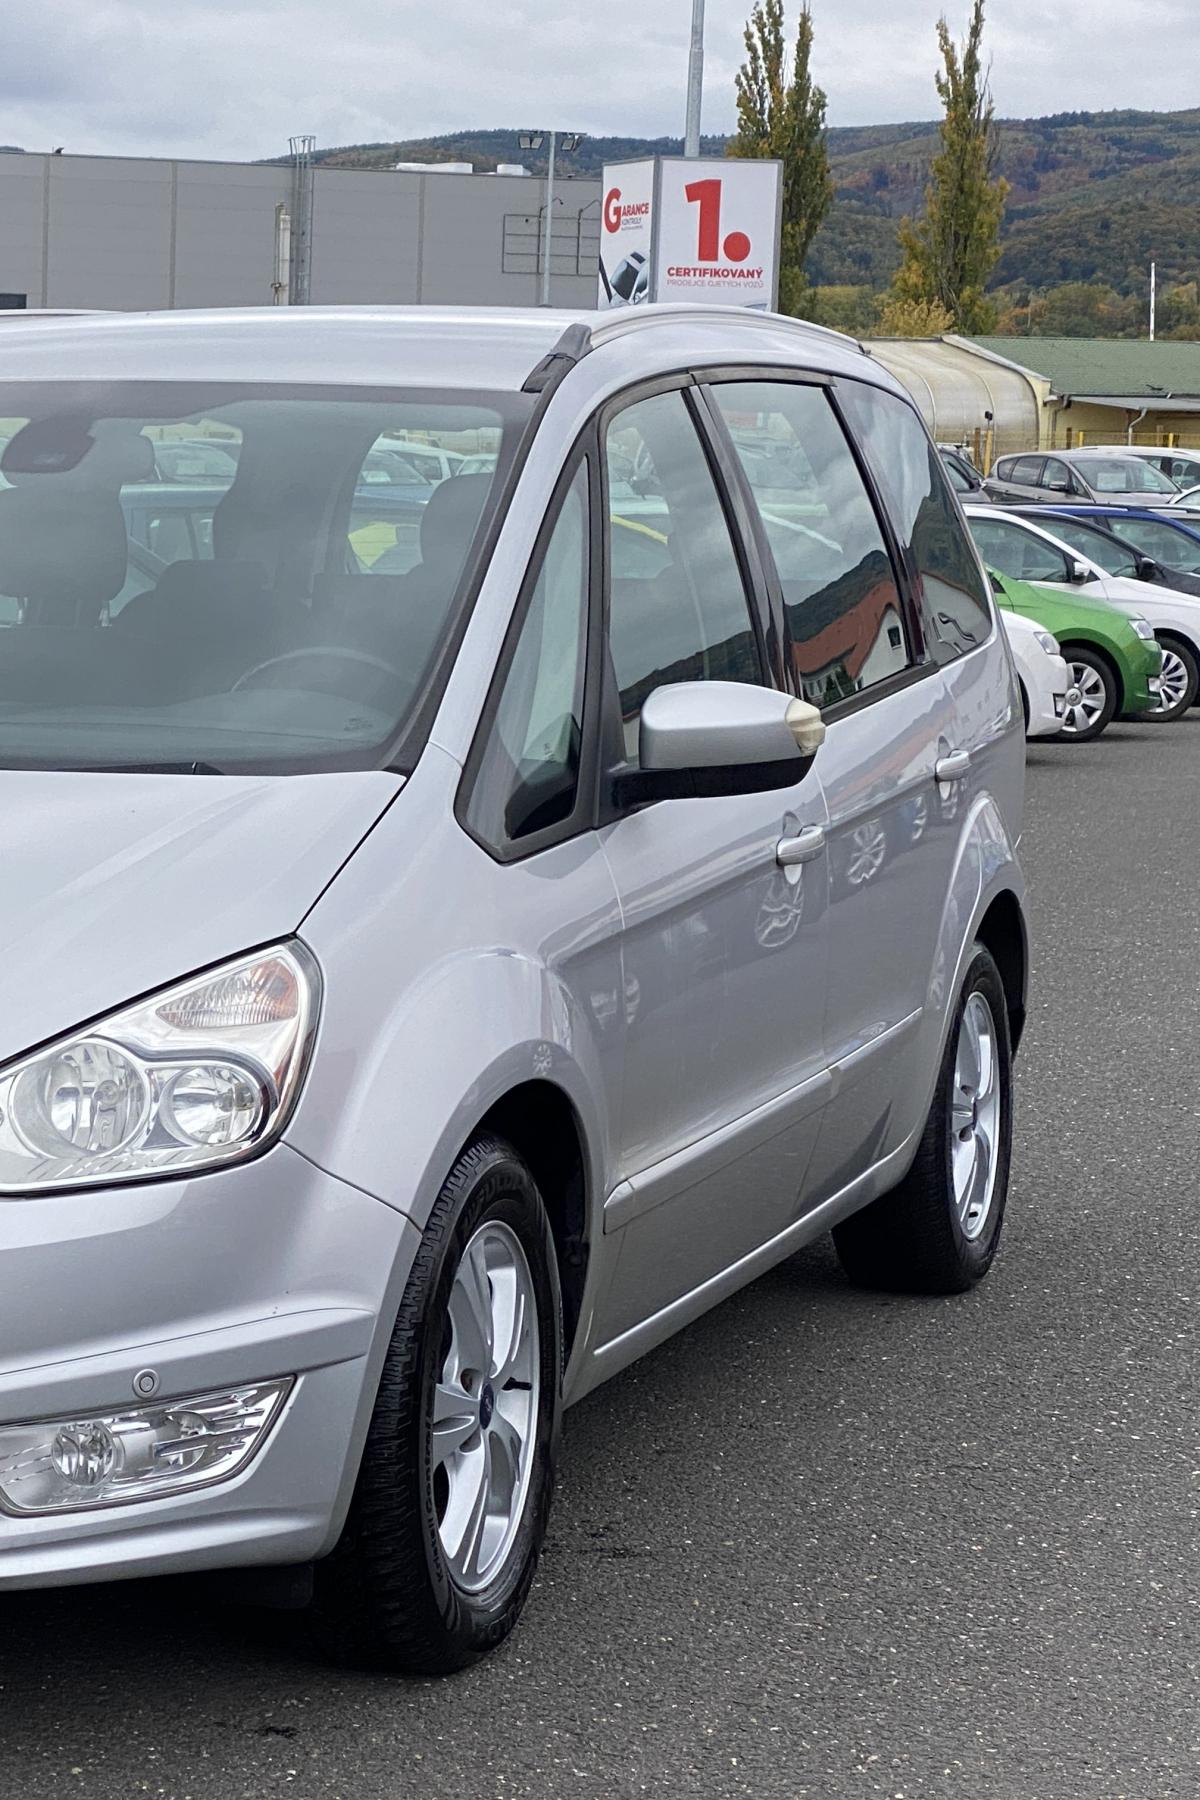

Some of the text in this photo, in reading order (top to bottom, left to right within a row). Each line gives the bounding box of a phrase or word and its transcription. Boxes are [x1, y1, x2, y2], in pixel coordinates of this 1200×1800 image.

[604, 187, 649, 234] GARANCE
[684, 179, 751, 262] 1.
[666, 279, 705, 288] PRODEJCE
[667, 266, 764, 279] CERTIFIKOVANÝ
